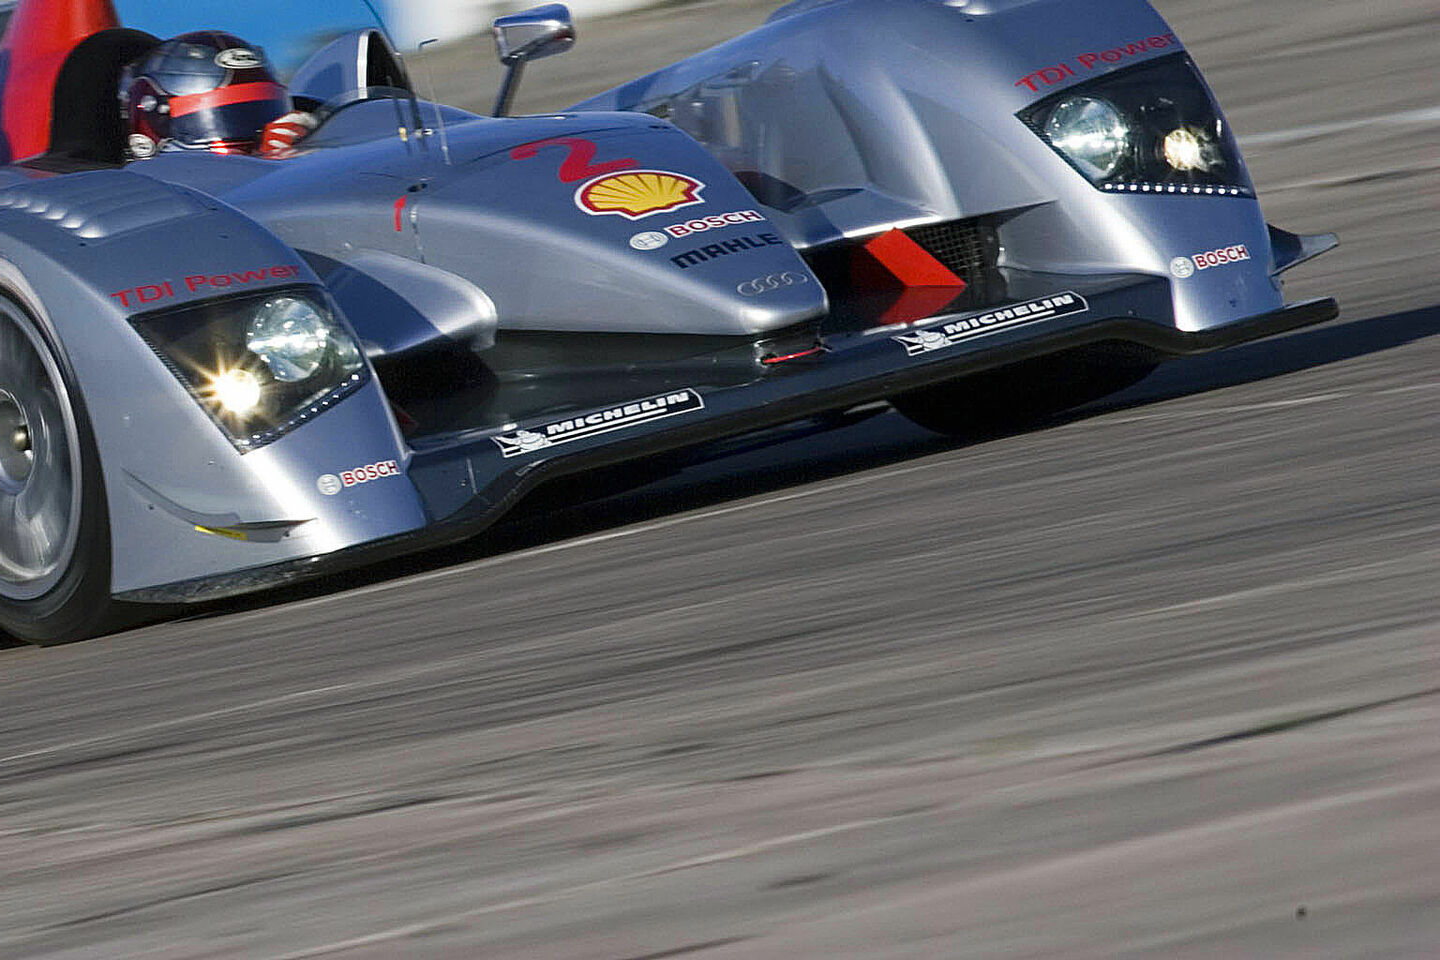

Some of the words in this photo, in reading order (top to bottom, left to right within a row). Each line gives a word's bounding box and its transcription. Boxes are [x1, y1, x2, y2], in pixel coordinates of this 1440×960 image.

[1014, 63, 1075, 92] TDI
[1077, 34, 1177, 70] Power
[510, 137, 641, 183] 2
[665, 210, 765, 238] BOSCH
[670, 233, 783, 269] MAHLE
[1193, 245, 1250, 270] BOSCH
[110, 281, 174, 308] TDI
[184, 265, 300, 293] Power
[943, 294, 1075, 334] MICHELIN
[547, 392, 690, 435] MICHELIN
[340, 460, 400, 487] BOSCH
